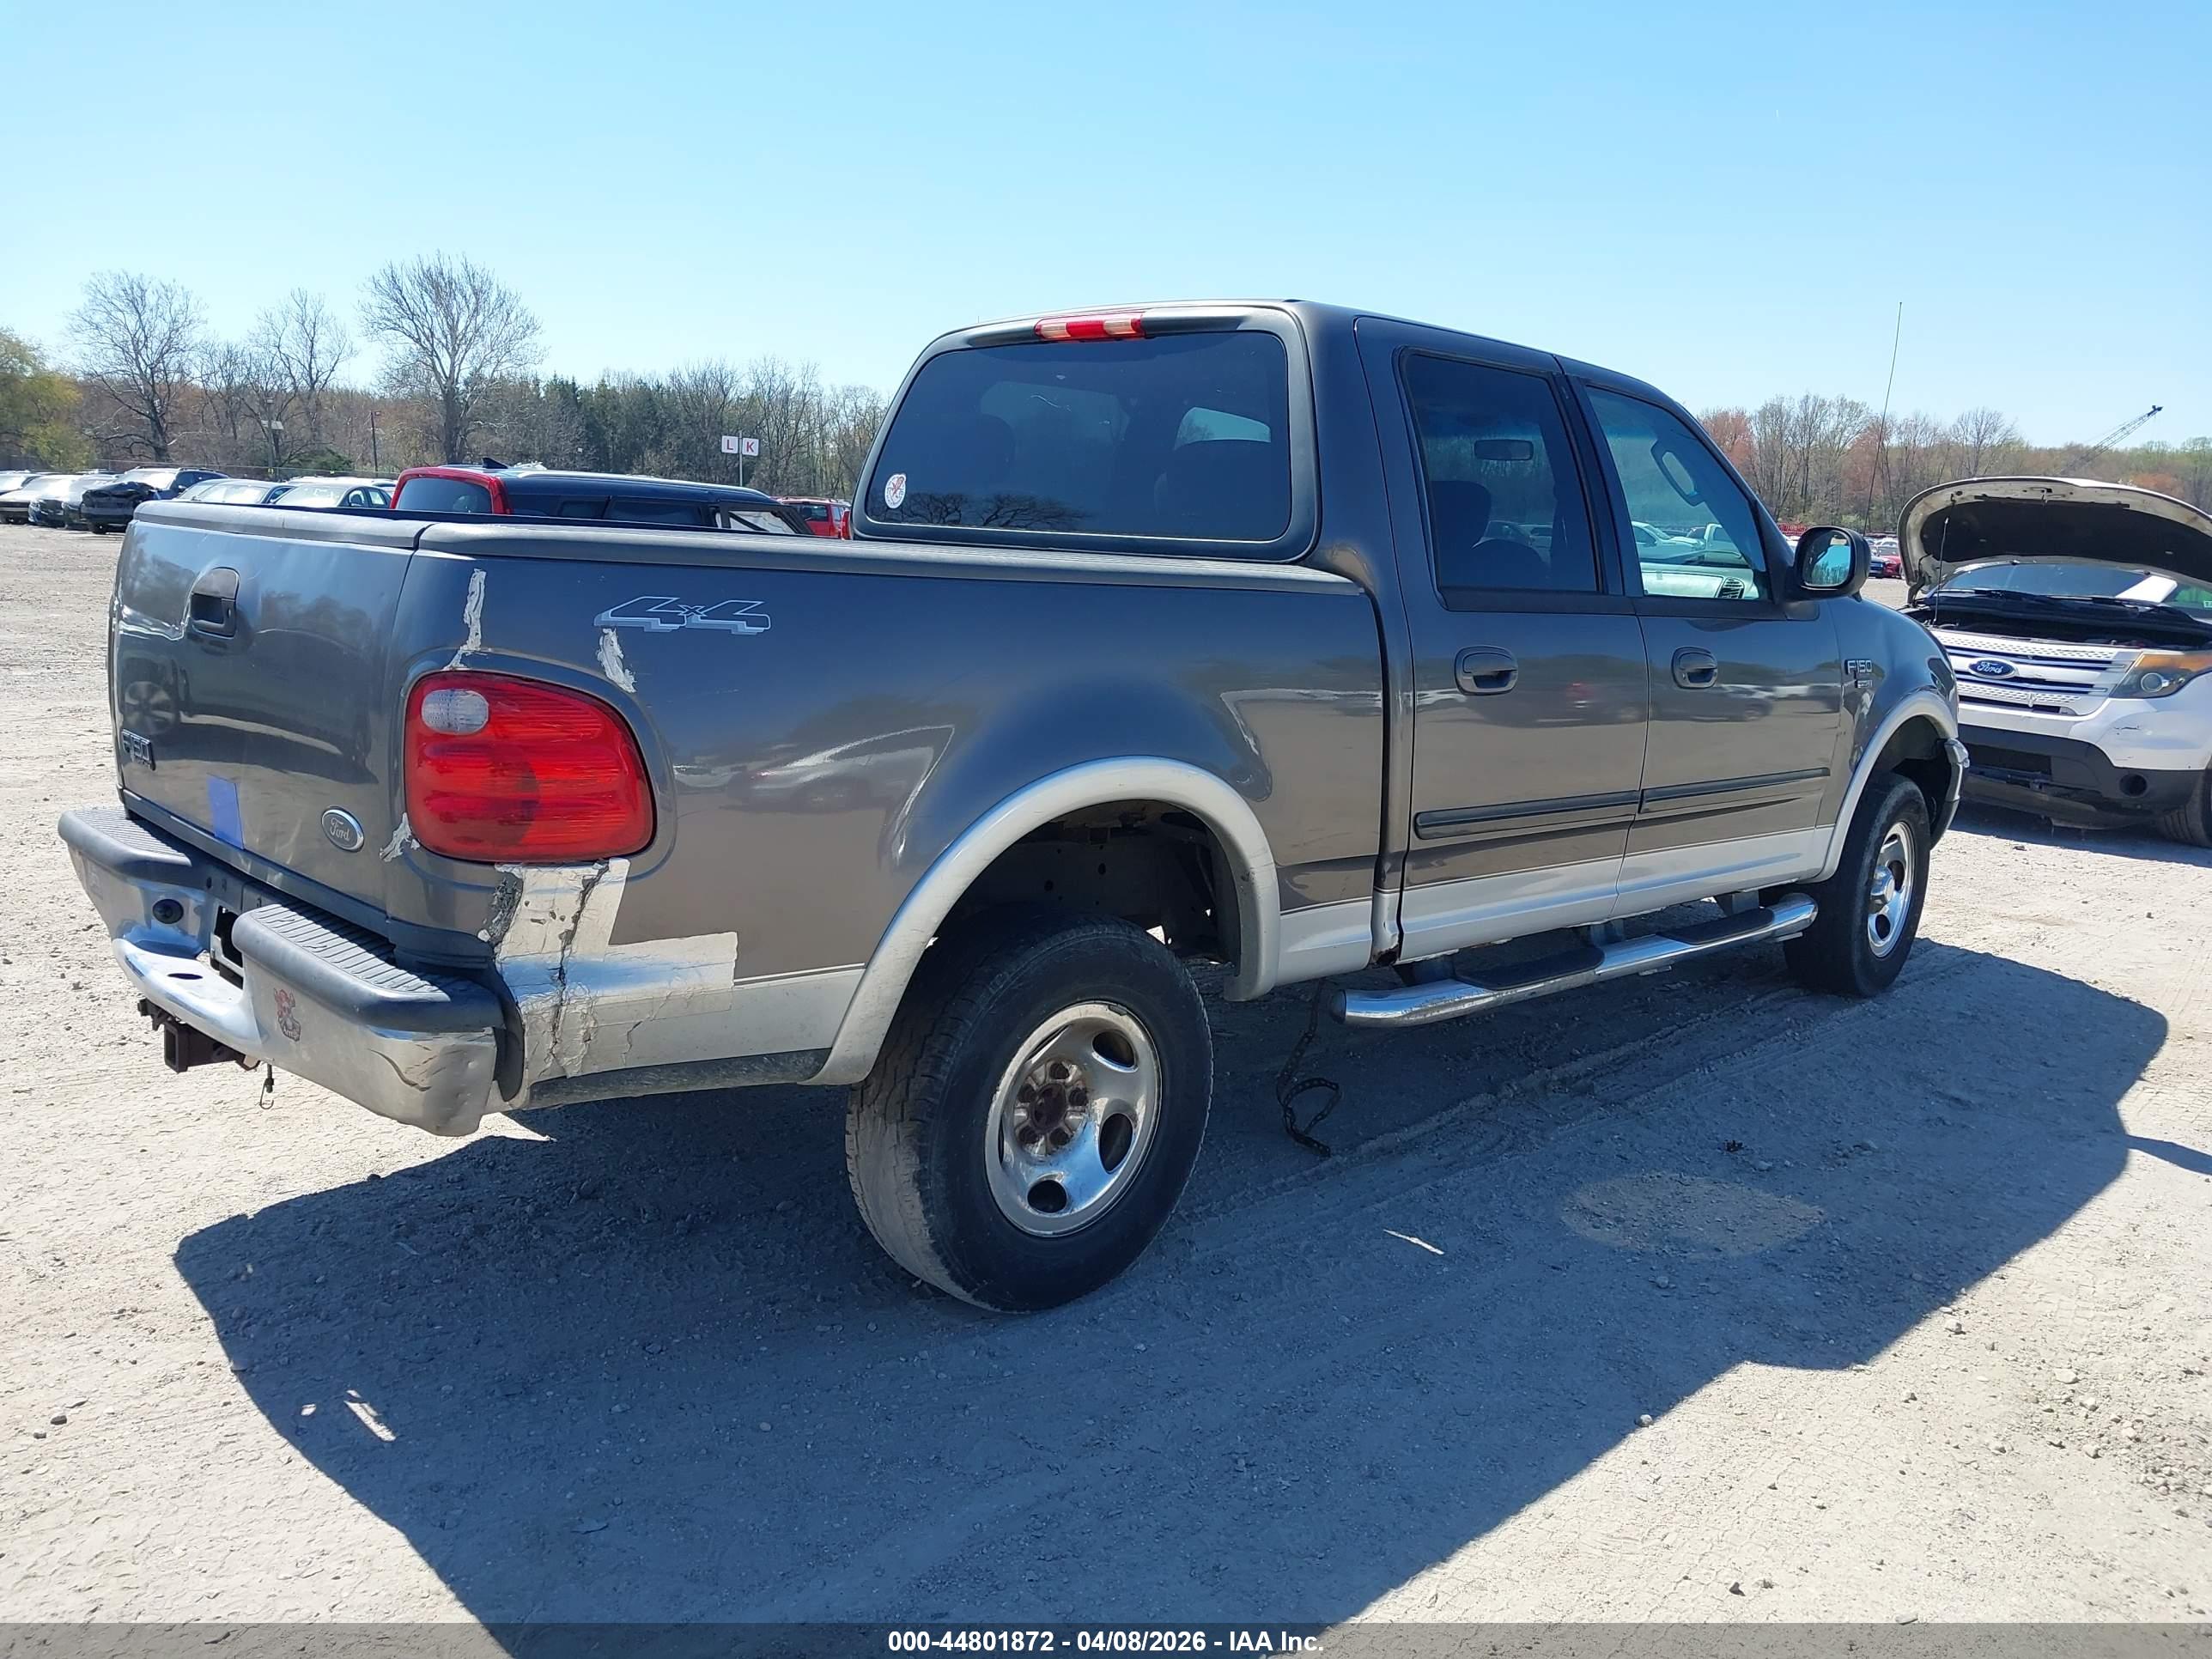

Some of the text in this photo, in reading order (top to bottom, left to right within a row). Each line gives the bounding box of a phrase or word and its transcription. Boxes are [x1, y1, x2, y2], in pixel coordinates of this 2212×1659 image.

[726, 439, 734, 451] L
[746, 441, 755, 453] K
[1847, 659, 1873, 674] F150
[1977, 661, 2004, 674] Ford
[330, 817, 349, 841] Ford
